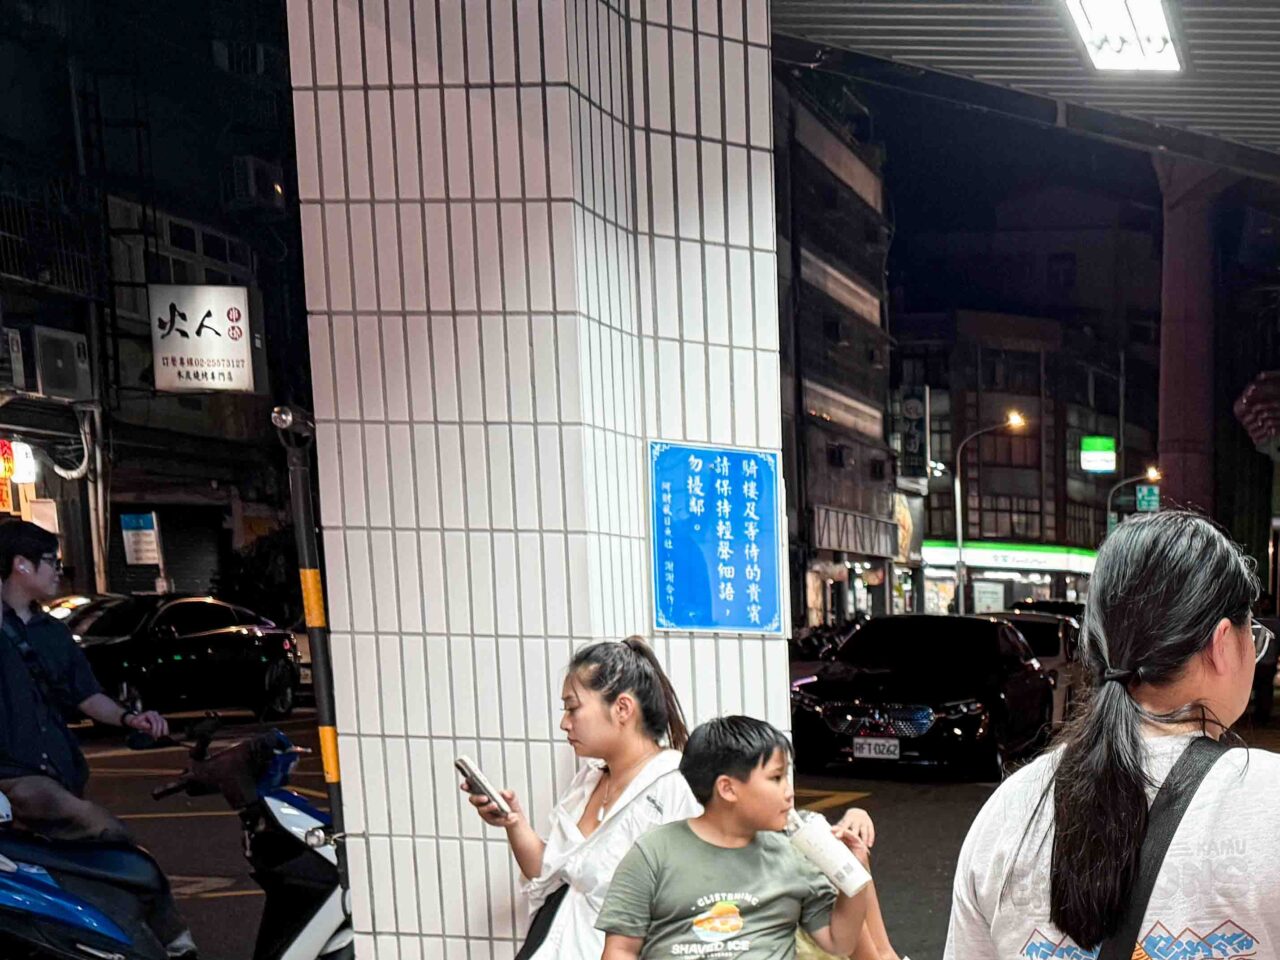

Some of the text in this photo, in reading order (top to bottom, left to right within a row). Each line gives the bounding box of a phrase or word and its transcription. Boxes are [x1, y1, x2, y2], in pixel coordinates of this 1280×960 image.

[741, 460, 762, 624] 騎樓及等待的貴賓
[670, 941, 724, 956] SHAVED
[726, 940, 751, 952] ICE
